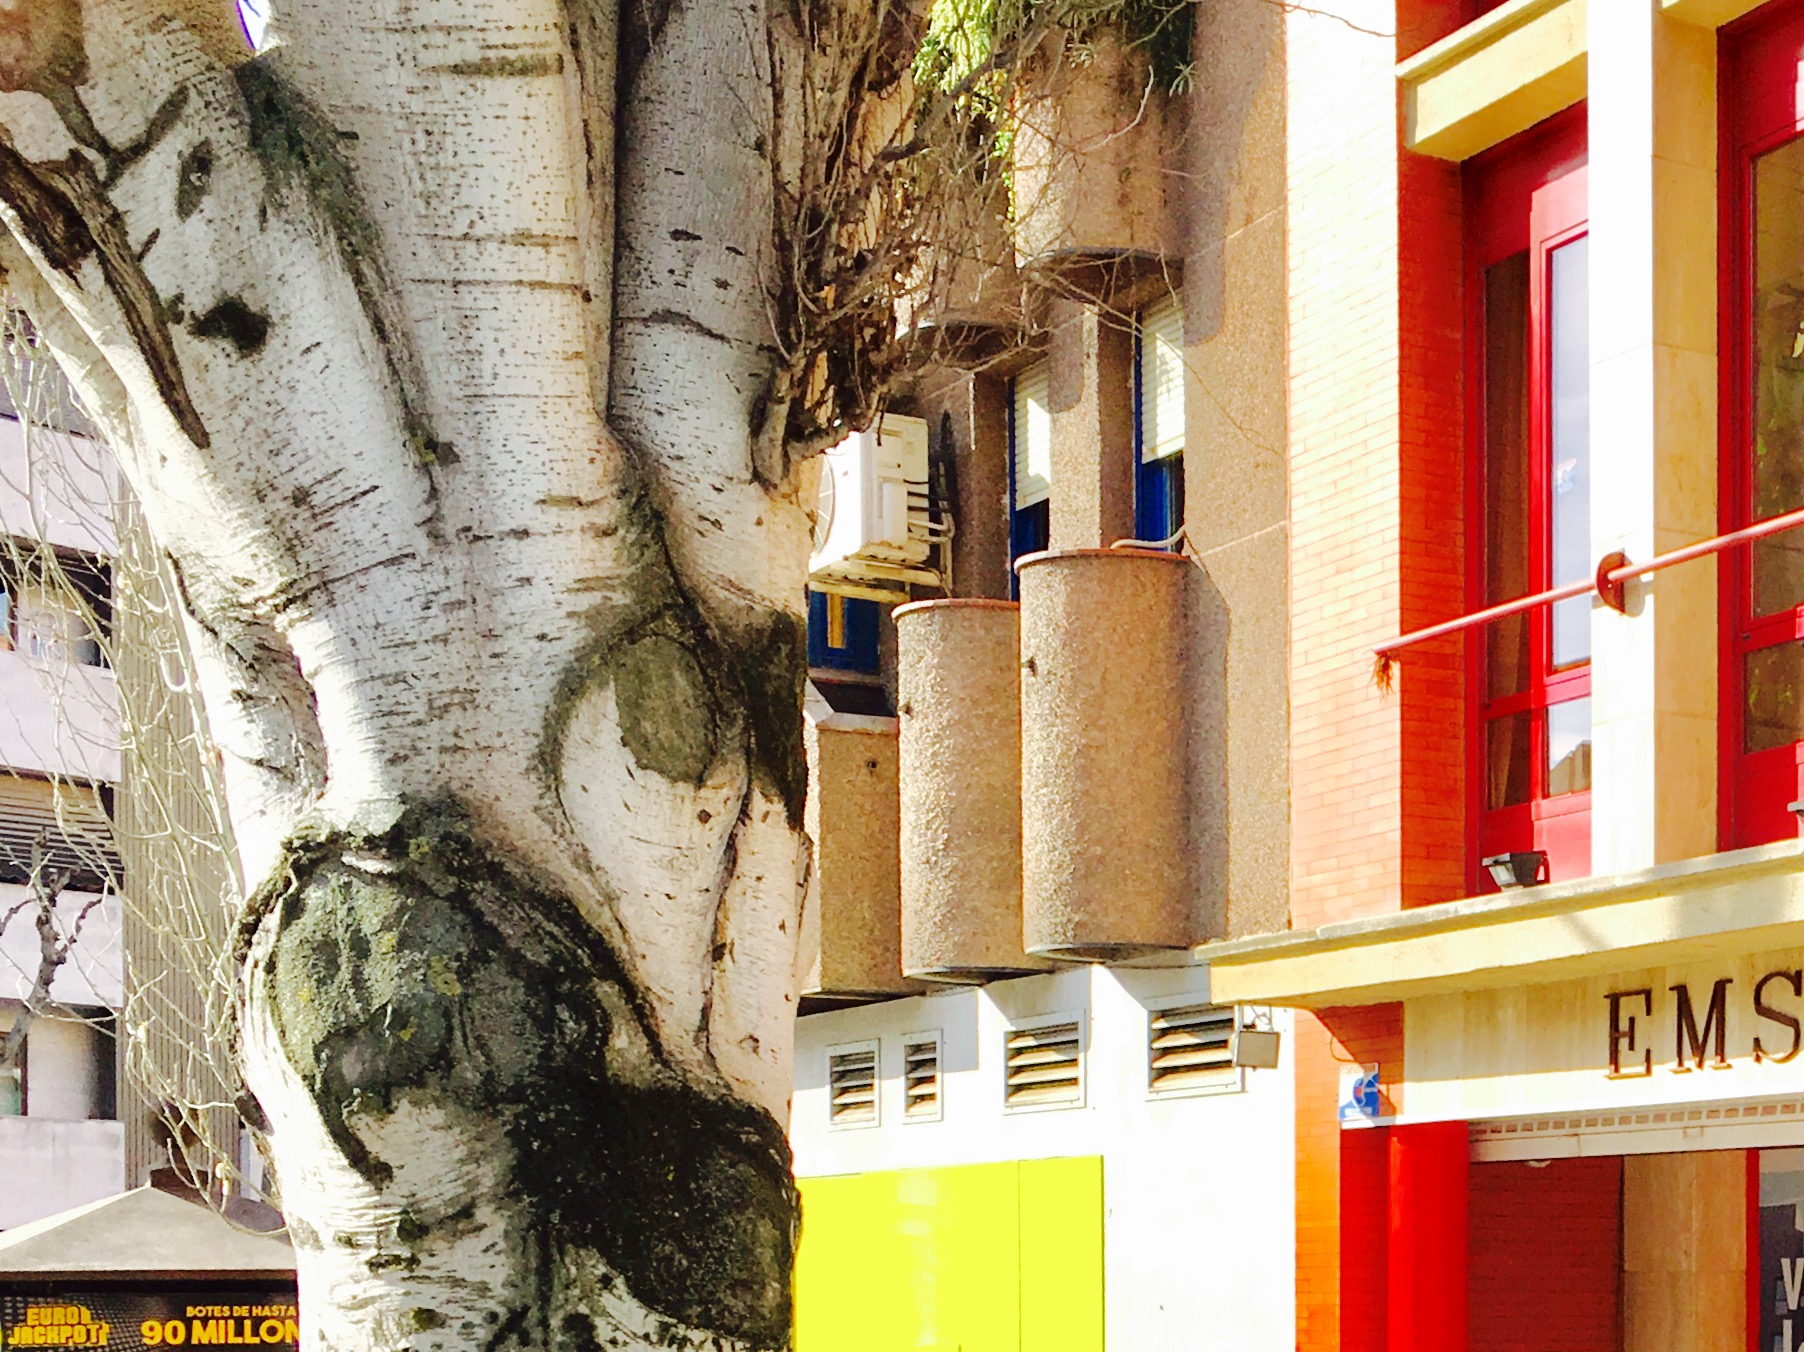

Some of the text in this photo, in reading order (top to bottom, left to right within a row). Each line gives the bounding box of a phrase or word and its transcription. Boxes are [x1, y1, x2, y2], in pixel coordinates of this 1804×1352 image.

[26, 1306, 92, 1326] EURO
[186, 1305, 296, 1317] BOTES DE HASTA
[8, 1325, 110, 1346] JACKPOT
[141, 1319, 298, 1346] 90 MILLON
